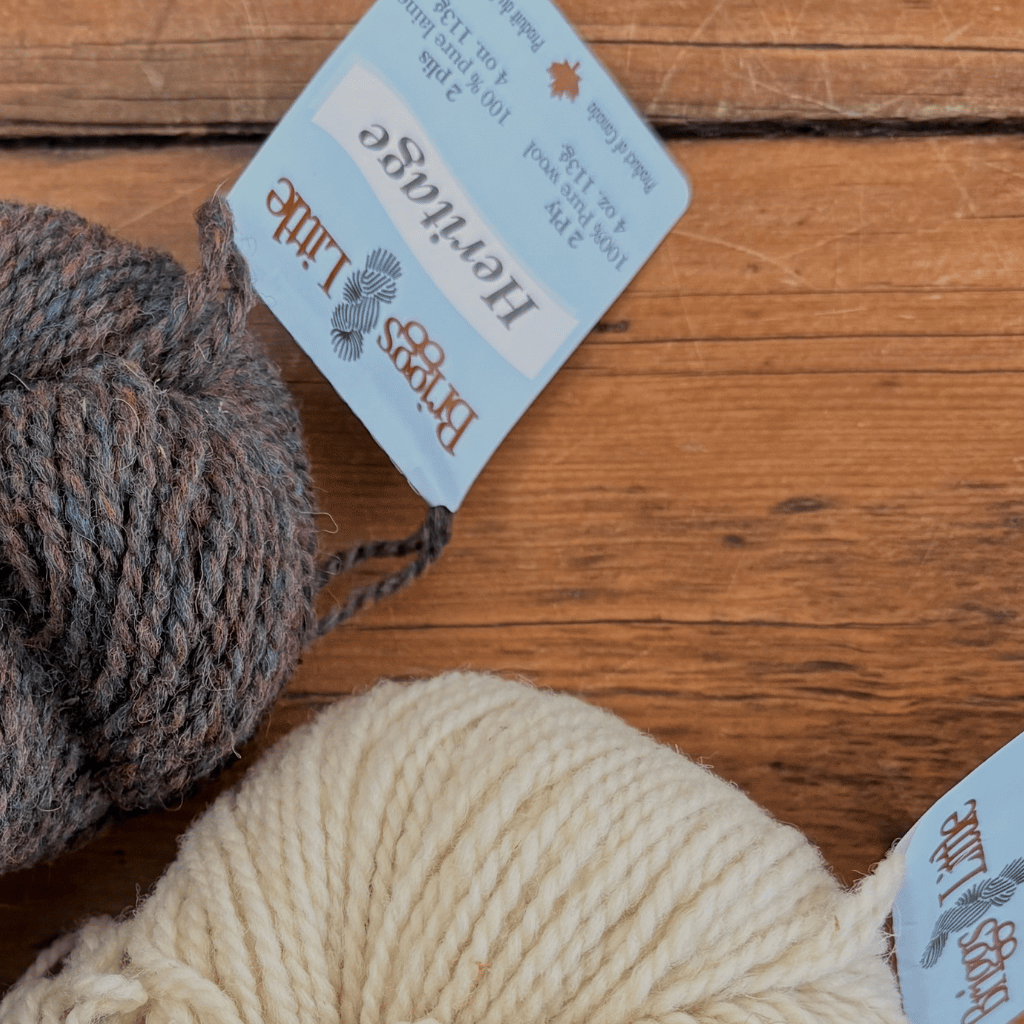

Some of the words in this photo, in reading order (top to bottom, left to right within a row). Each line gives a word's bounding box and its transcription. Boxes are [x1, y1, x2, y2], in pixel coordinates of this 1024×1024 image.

[509, 10, 546, 53] Produit
[419, 50, 452, 85] plis
[434, 33, 474, 75] pure
[476, 40, 497, 71] on.
[445, 83, 463, 102] 2
[465, 73, 484, 95] %
[494, 69, 509, 86] 4
[480, 90, 511, 126] 100
[587, 101, 618, 145] Canada
[523, 140, 561, 185] wool
[612, 139, 628, 155] of
[559, 143, 595, 194] 113g.
[624, 151, 658, 195] Product
[544, 200, 572, 236] Ply
[560, 183, 595, 229] Pure
[597, 190, 616, 219] oz.
[266, 177, 352, 299] Little
[358, 123, 540, 331] Heritage
[567, 230, 585, 249] 2
[589, 221, 629, 271] 100%
[613, 218, 627, 234] 4
[376, 317, 479, 456] Briggs
[929, 798, 988, 907] Little
